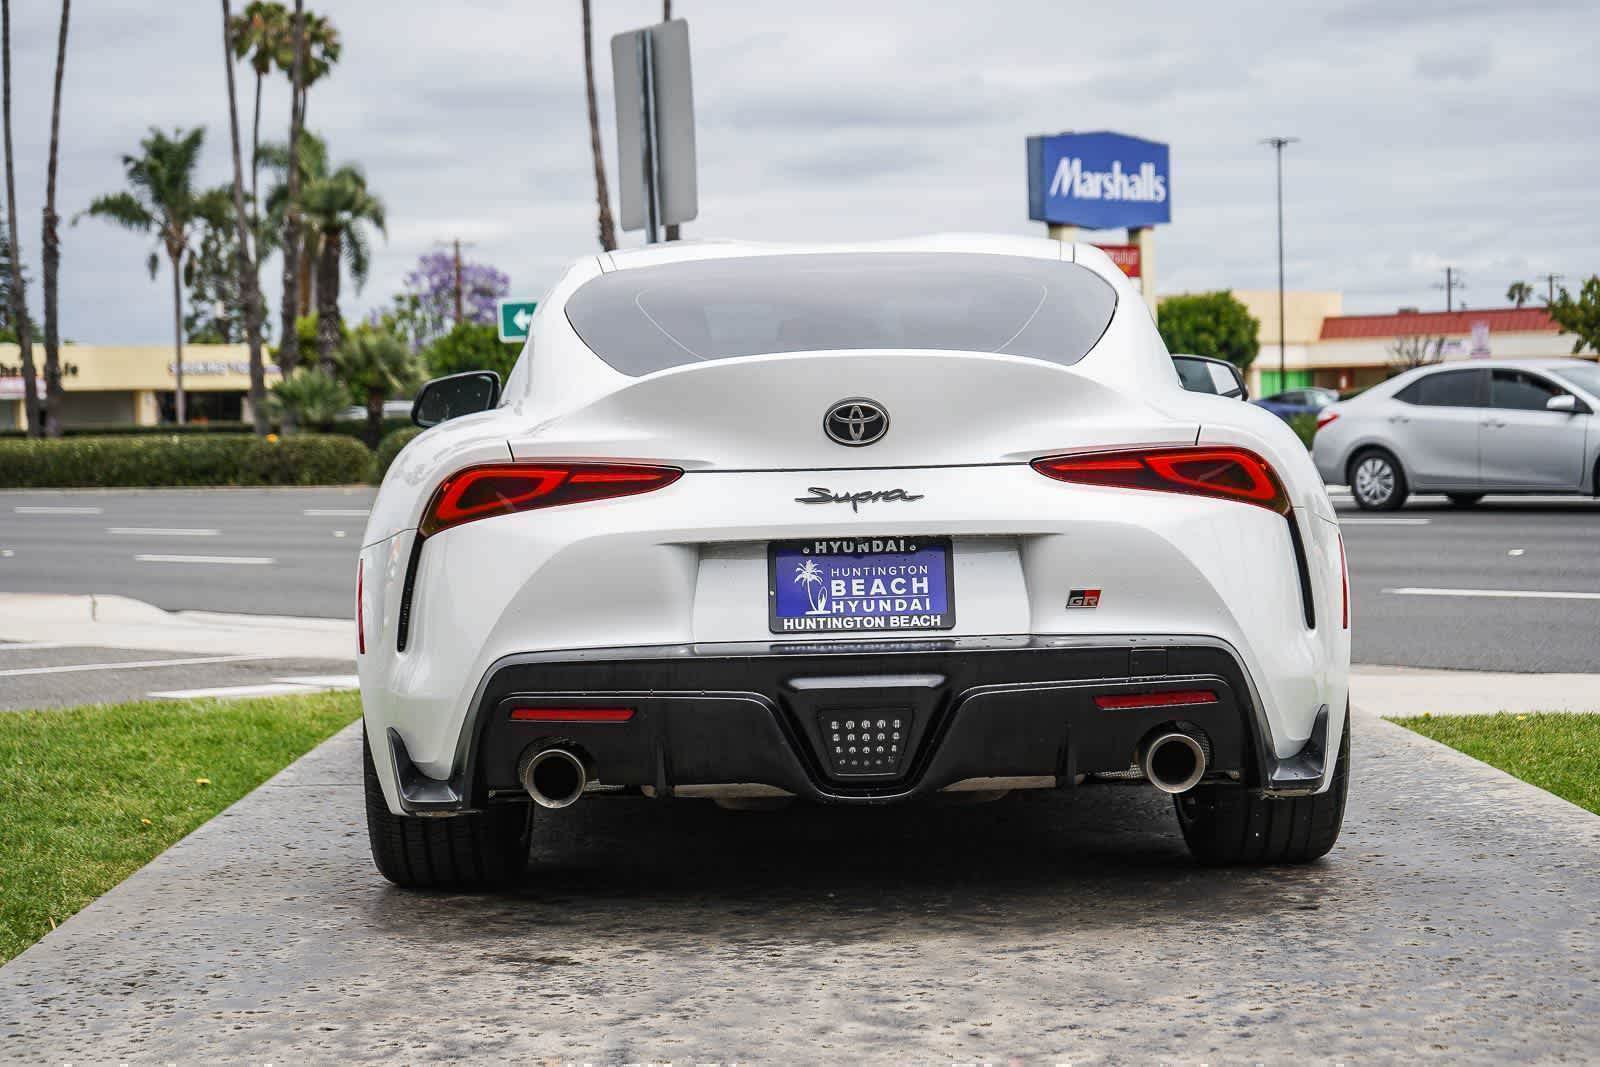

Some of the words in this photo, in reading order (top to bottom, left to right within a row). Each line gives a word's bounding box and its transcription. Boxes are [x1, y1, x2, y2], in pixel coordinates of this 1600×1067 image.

[1050, 156, 1167, 203] Marshalls
[794, 486, 925, 514] Supra
[815, 539, 905, 554] HYUNDAI
[831, 565, 928, 577] HUNTINGTON
[831, 577, 929, 597] BEACH
[832, 598, 931, 614] HYUNDAI
[1069, 596, 1098, 606] GR
[783, 616, 885, 630] HUNTINGTON
[889, 615, 941, 628] BEACH
